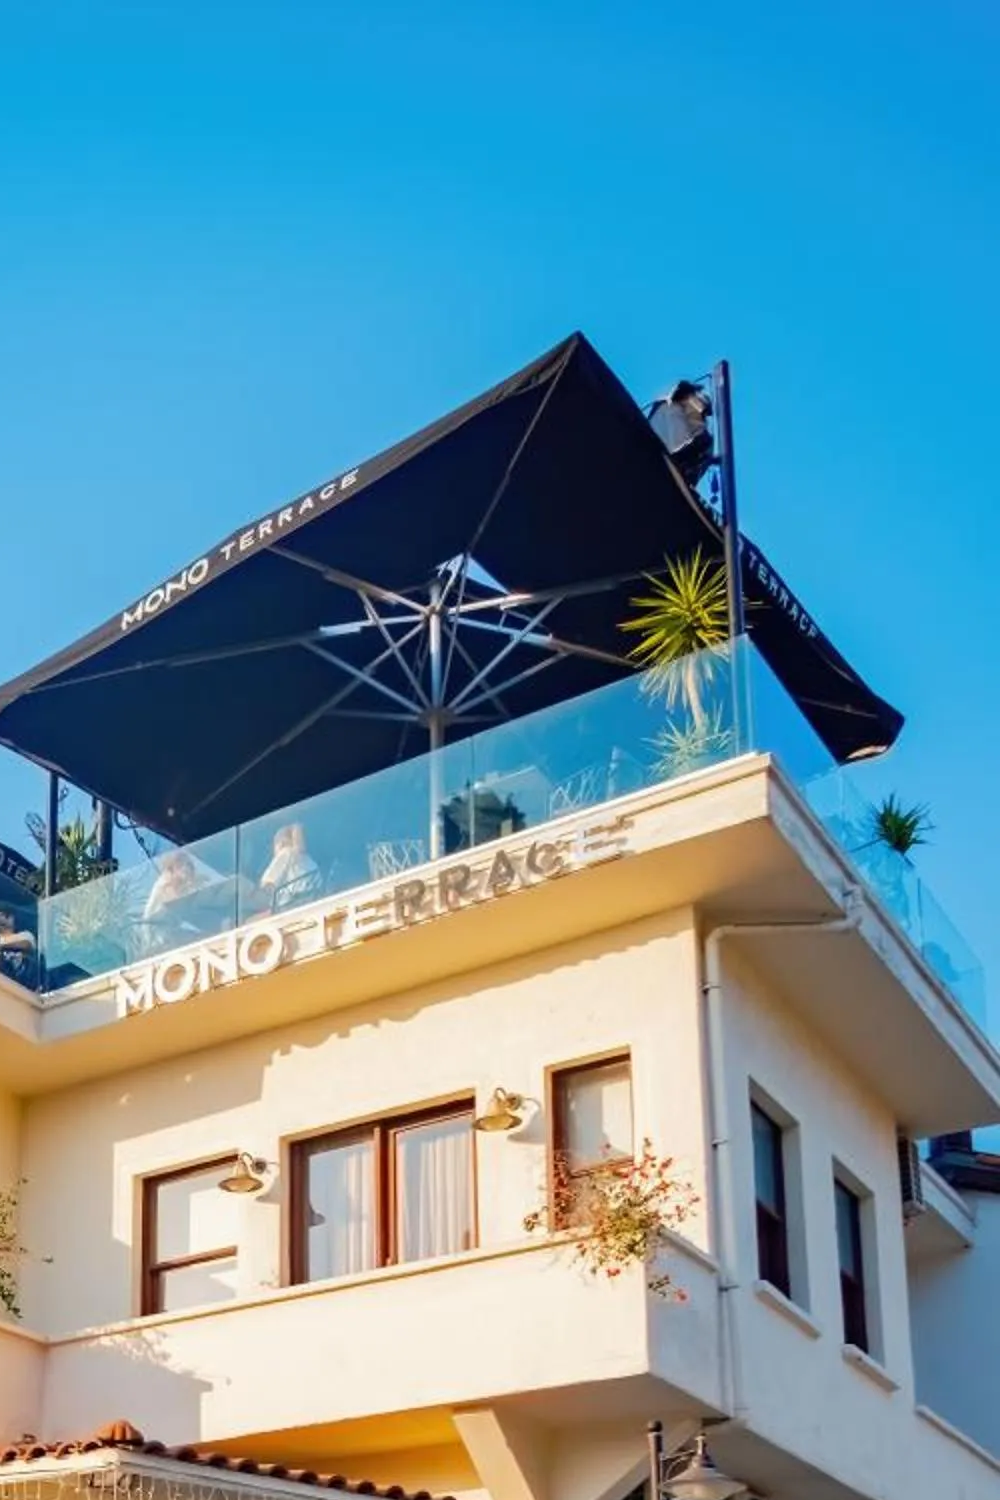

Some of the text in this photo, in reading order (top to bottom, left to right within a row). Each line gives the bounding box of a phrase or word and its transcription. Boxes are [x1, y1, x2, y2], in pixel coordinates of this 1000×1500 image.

[120, 469, 359, 631] MONO TERRACE
[115, 815, 635, 1020] MONO TERRACE
